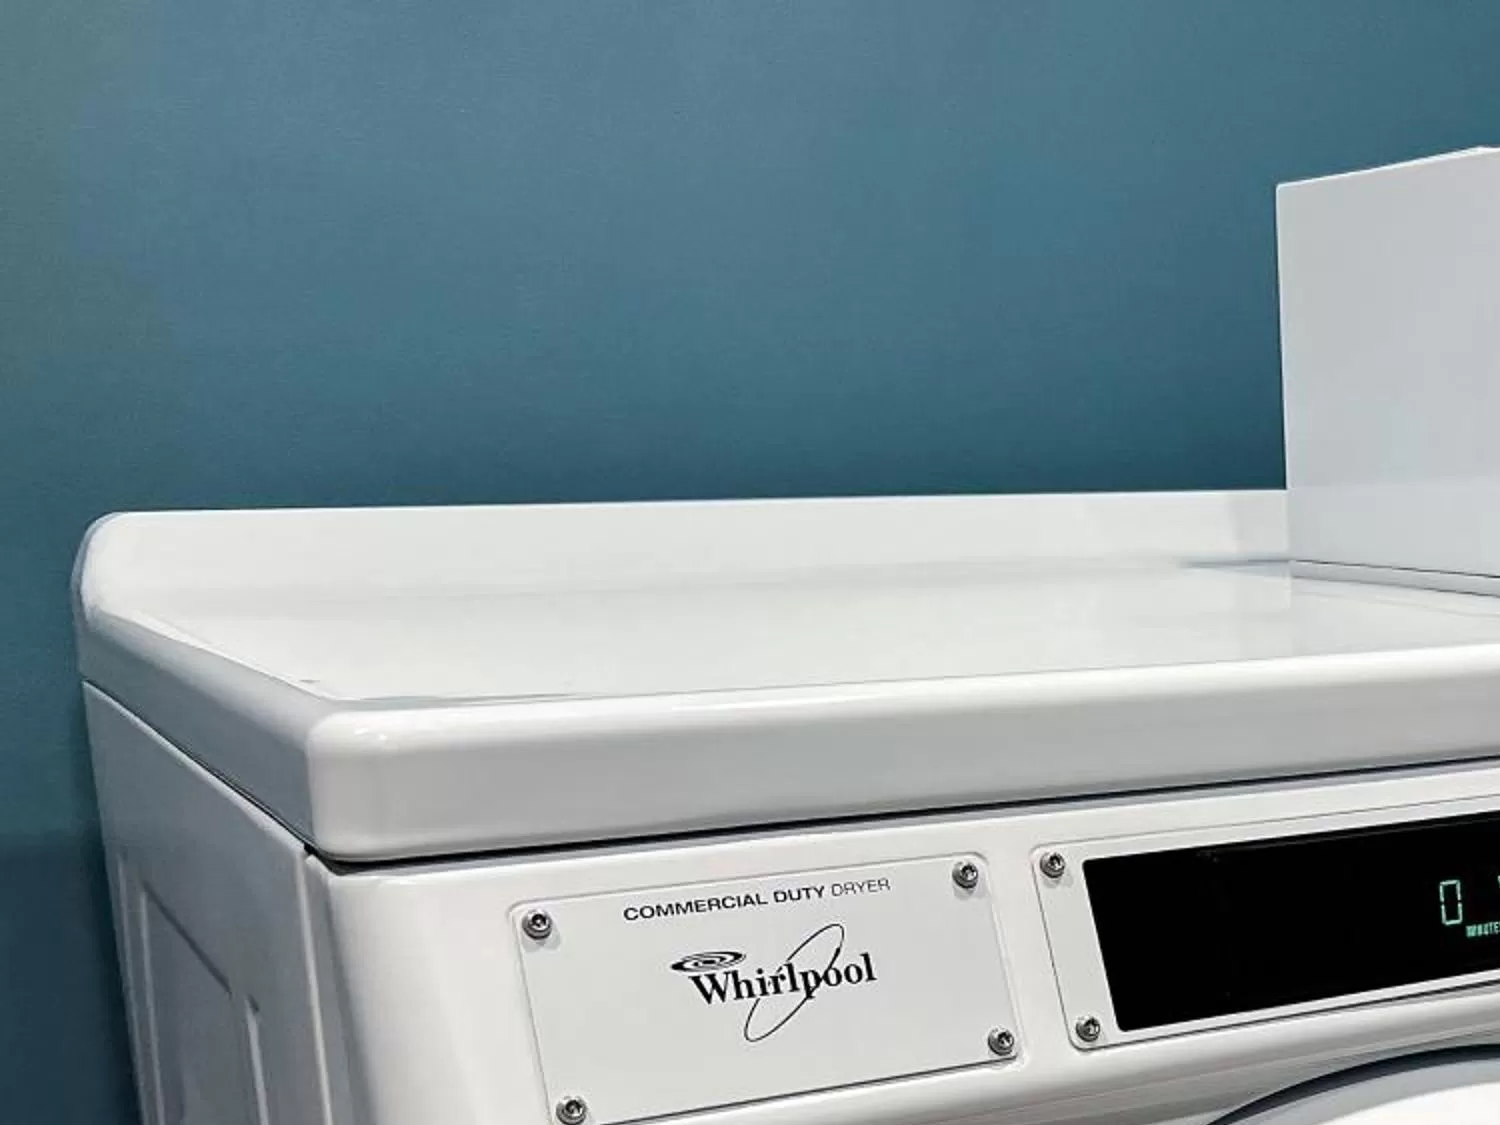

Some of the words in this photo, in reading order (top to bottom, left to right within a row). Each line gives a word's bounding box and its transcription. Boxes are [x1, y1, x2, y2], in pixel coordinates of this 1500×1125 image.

[623, 892, 768, 922] COMMERCIAL
[773, 885, 826, 905] DUTY
[830, 876, 891, 898] DRYER
[689, 952, 878, 1006] Whirlpool
